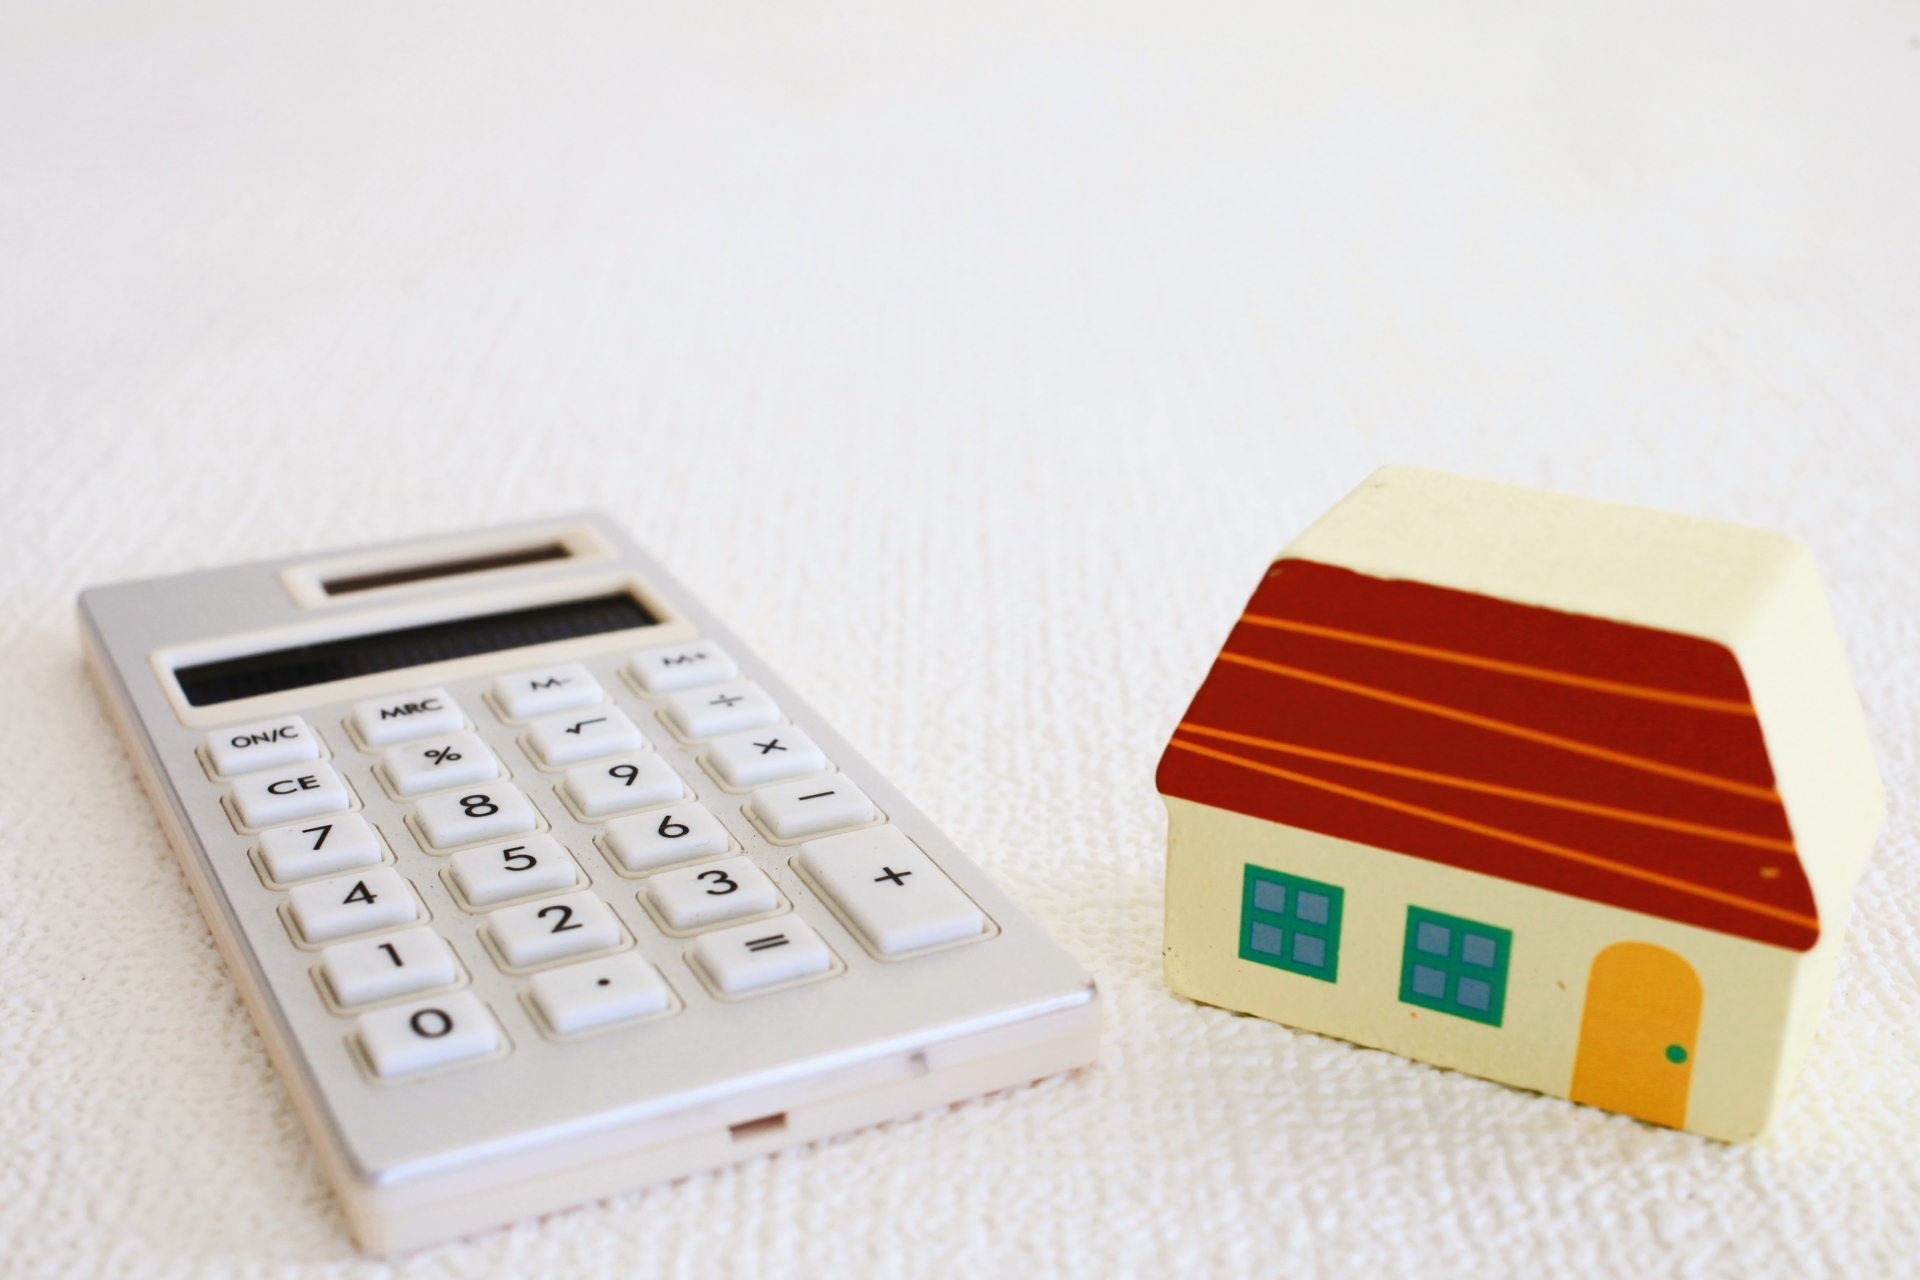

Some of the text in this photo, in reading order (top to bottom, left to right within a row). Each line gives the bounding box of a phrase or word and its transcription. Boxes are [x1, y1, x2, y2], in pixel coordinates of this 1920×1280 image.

[380, 698, 444, 720] MRC
[230, 726, 299, 749] ON/C
[423, 746, 462, 766] %
[267, 775, 321, 795] CE
[608, 764, 639, 787] 9
[459, 794, 499, 818] 8
[301, 824, 333, 851] 7
[657, 815, 690, 839] 6
[502, 845, 538, 872] 5
[697, 869, 739, 896] 3
[874, 866, 913, 887] +
[342, 880, 378, 905] 4
[537, 904, 583, 934] 2
[378, 942, 404, 968] 1
[744, 933, 790, 953] =
[409, 1008, 454, 1039] 0
